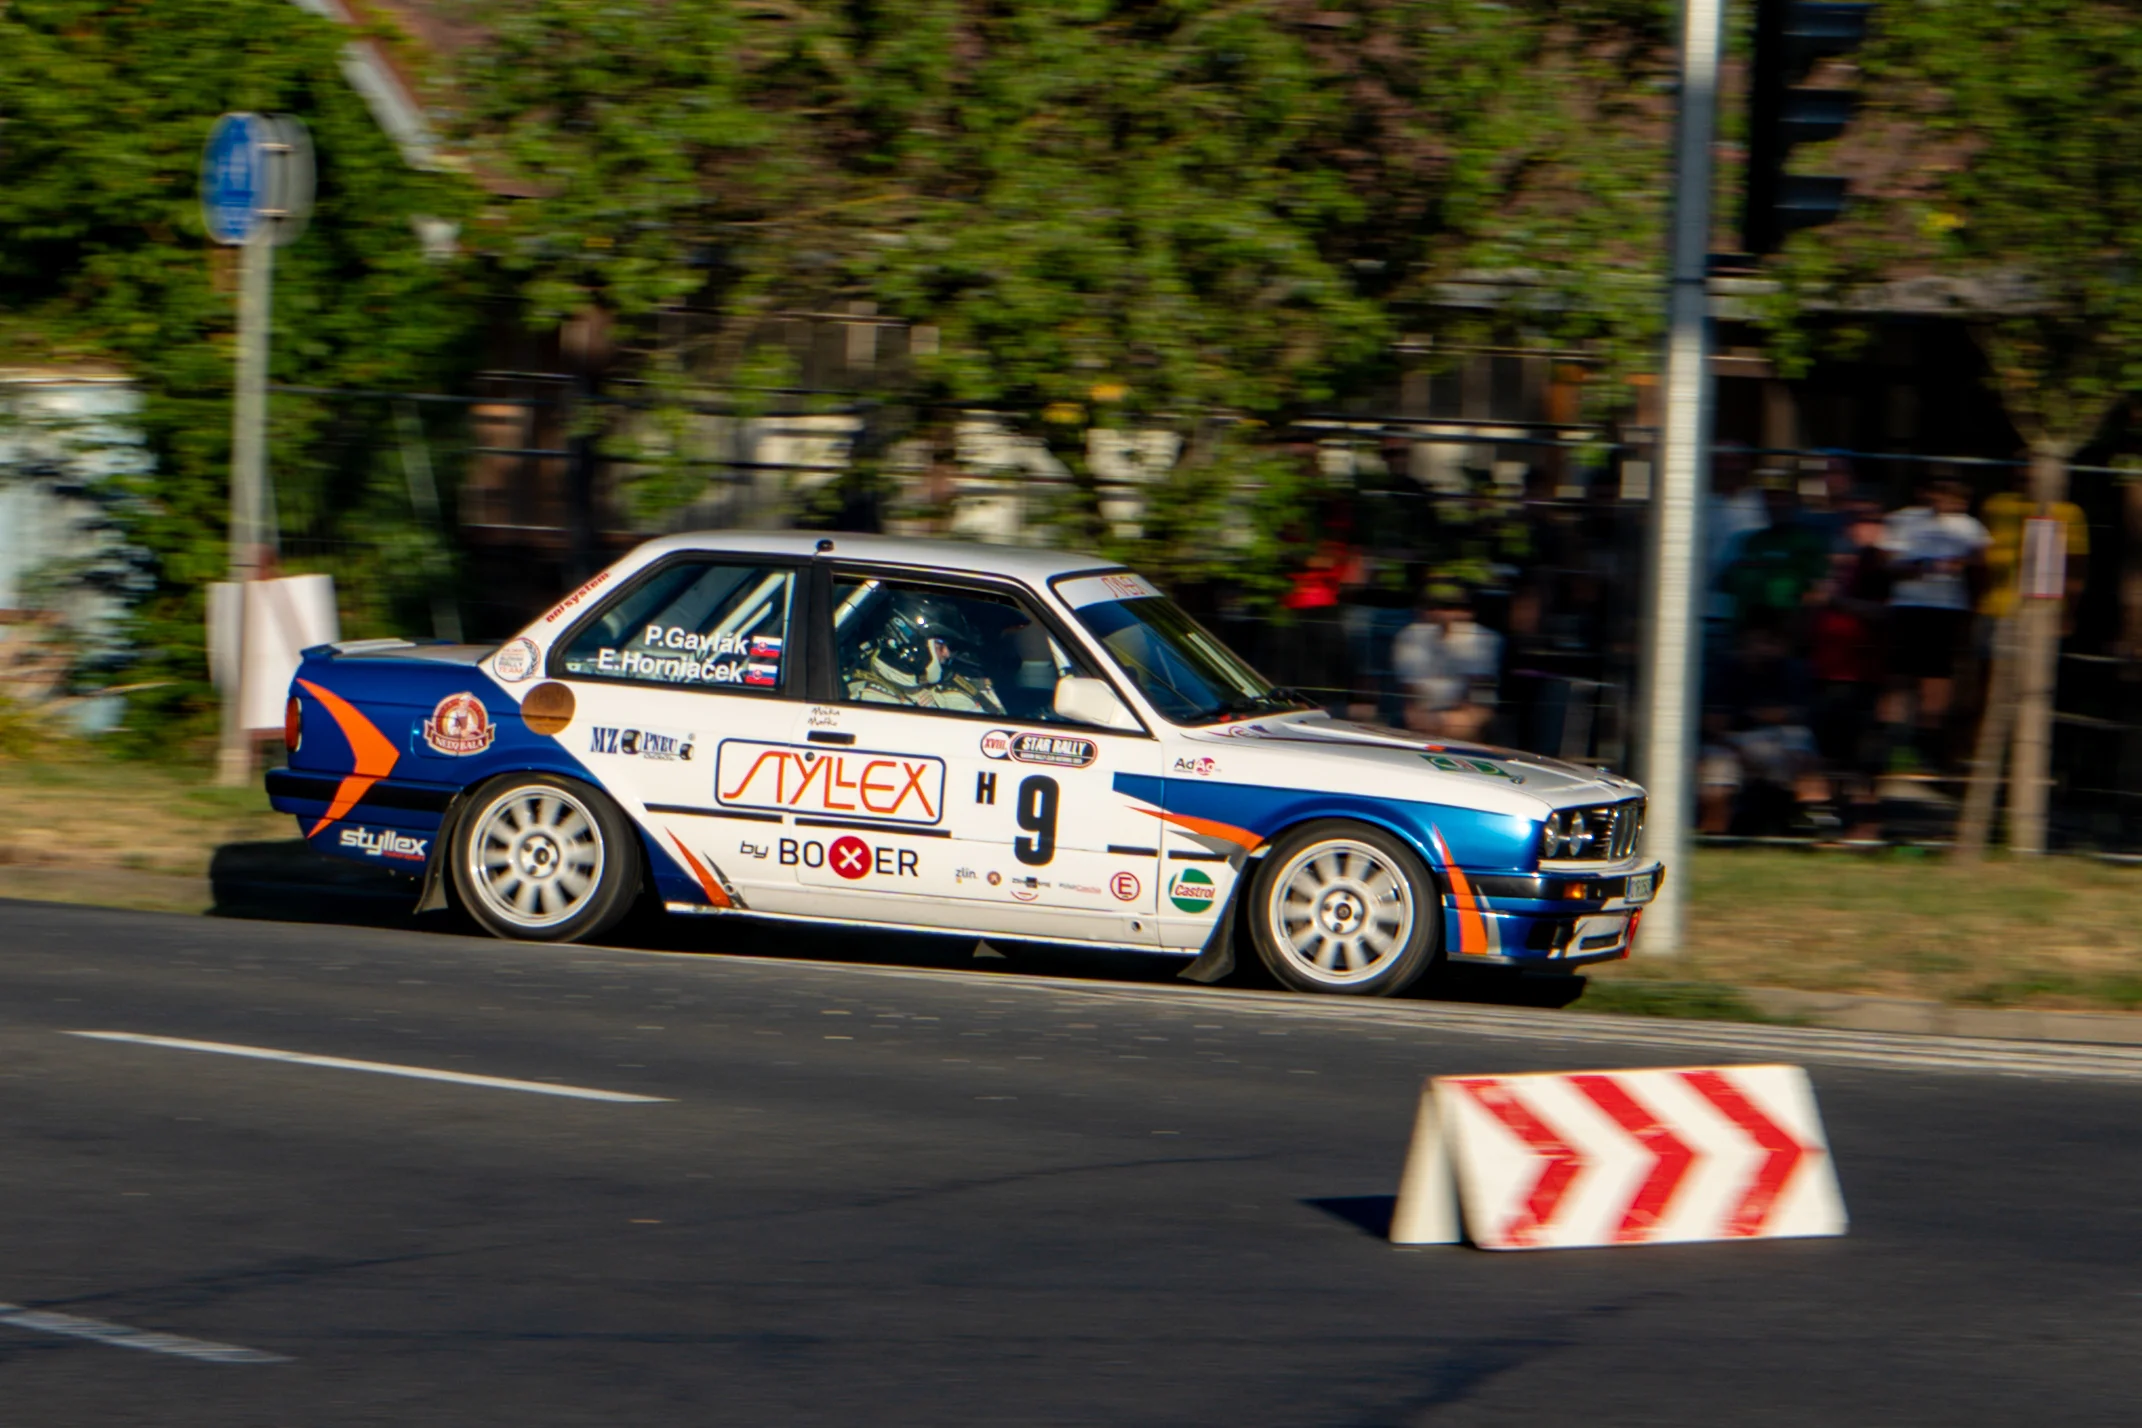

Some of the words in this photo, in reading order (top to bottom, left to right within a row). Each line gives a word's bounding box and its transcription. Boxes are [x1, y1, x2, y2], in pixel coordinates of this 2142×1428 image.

[644, 624, 749, 655] P.Gavlák
[597, 648, 744, 683] E.Horniaček
[590, 726, 619, 754] MZ
[643, 731, 678, 753] PNEU
[1023, 736, 1052, 752] STAR
[1053, 738, 1087, 755] RALLY
[976, 771, 997, 805] H
[1014, 774, 1060, 867] 9
[339, 825, 428, 856] styllex
[740, 841, 769, 859] by
[779, 836, 919, 879] BOXER
[1175, 884, 1215, 898] Castrol
